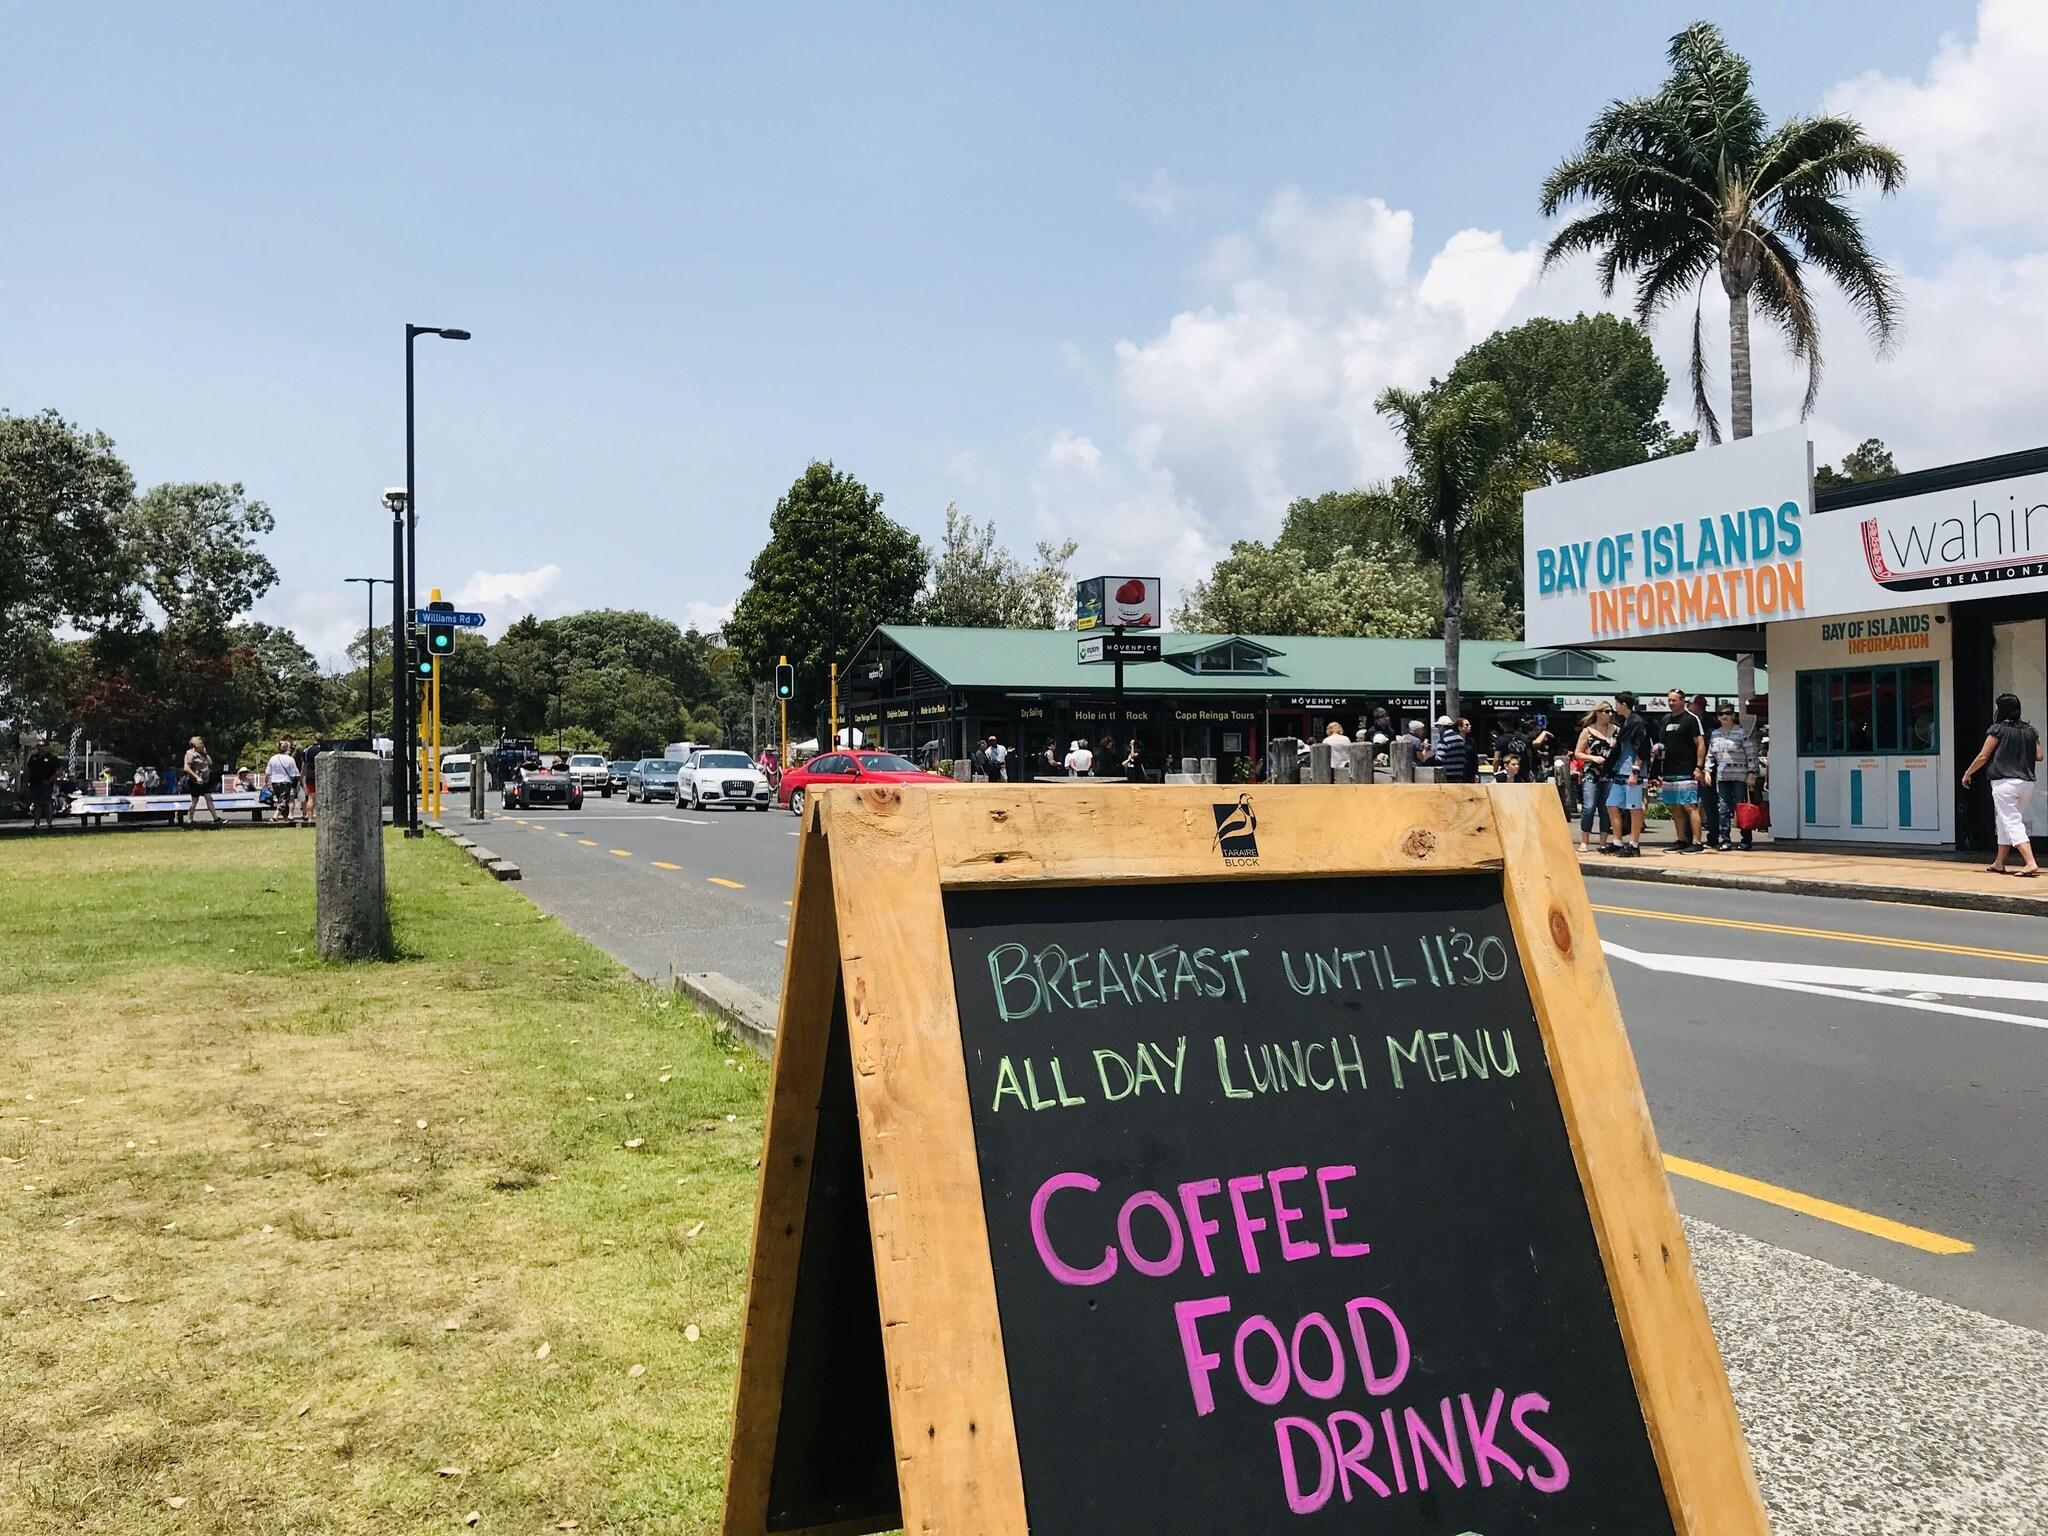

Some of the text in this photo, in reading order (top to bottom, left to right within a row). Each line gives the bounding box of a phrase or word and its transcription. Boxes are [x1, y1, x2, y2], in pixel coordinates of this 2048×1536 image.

[1536, 501, 1801, 595] BAY OF ISLANDS
[1932, 565, 2044, 587] CREATIONZ
[1589, 560, 1805, 634] INFORMATION
[422, 612, 457, 623] Williams
[459, 614, 471, 624] Rd
[1822, 614, 1930, 641] BAY OF ISLANDS
[1106, 643, 1158, 651] MÖVENPICK
[1848, 633, 1929, 655] INFORMATION
[1291, 697, 1347, 705] MÖVENPICK
[1388, 698, 1442, 706] MÖVENPIK
[1075, 711, 1096, 720] Hole
[1098, 711, 1107, 720] in
[1126, 711, 1148, 720] Rock
[1175, 710, 1255, 721] Cape Reinga Tours
[1223, 848, 1257, 857] TARAIRE
[1224, 858, 1260, 867] BLOCK
[988, 942, 1249, 1022] BREAKFAST
[1281, 945, 1416, 996] UNTIL
[992, 1027, 1521, 1112] ALL DAY LUNCH MENU
[1030, 1164, 1370, 1286] COFFEE
[1173, 1295, 1411, 1416] FOOD
[1274, 1387, 1570, 1515] DRINKS
